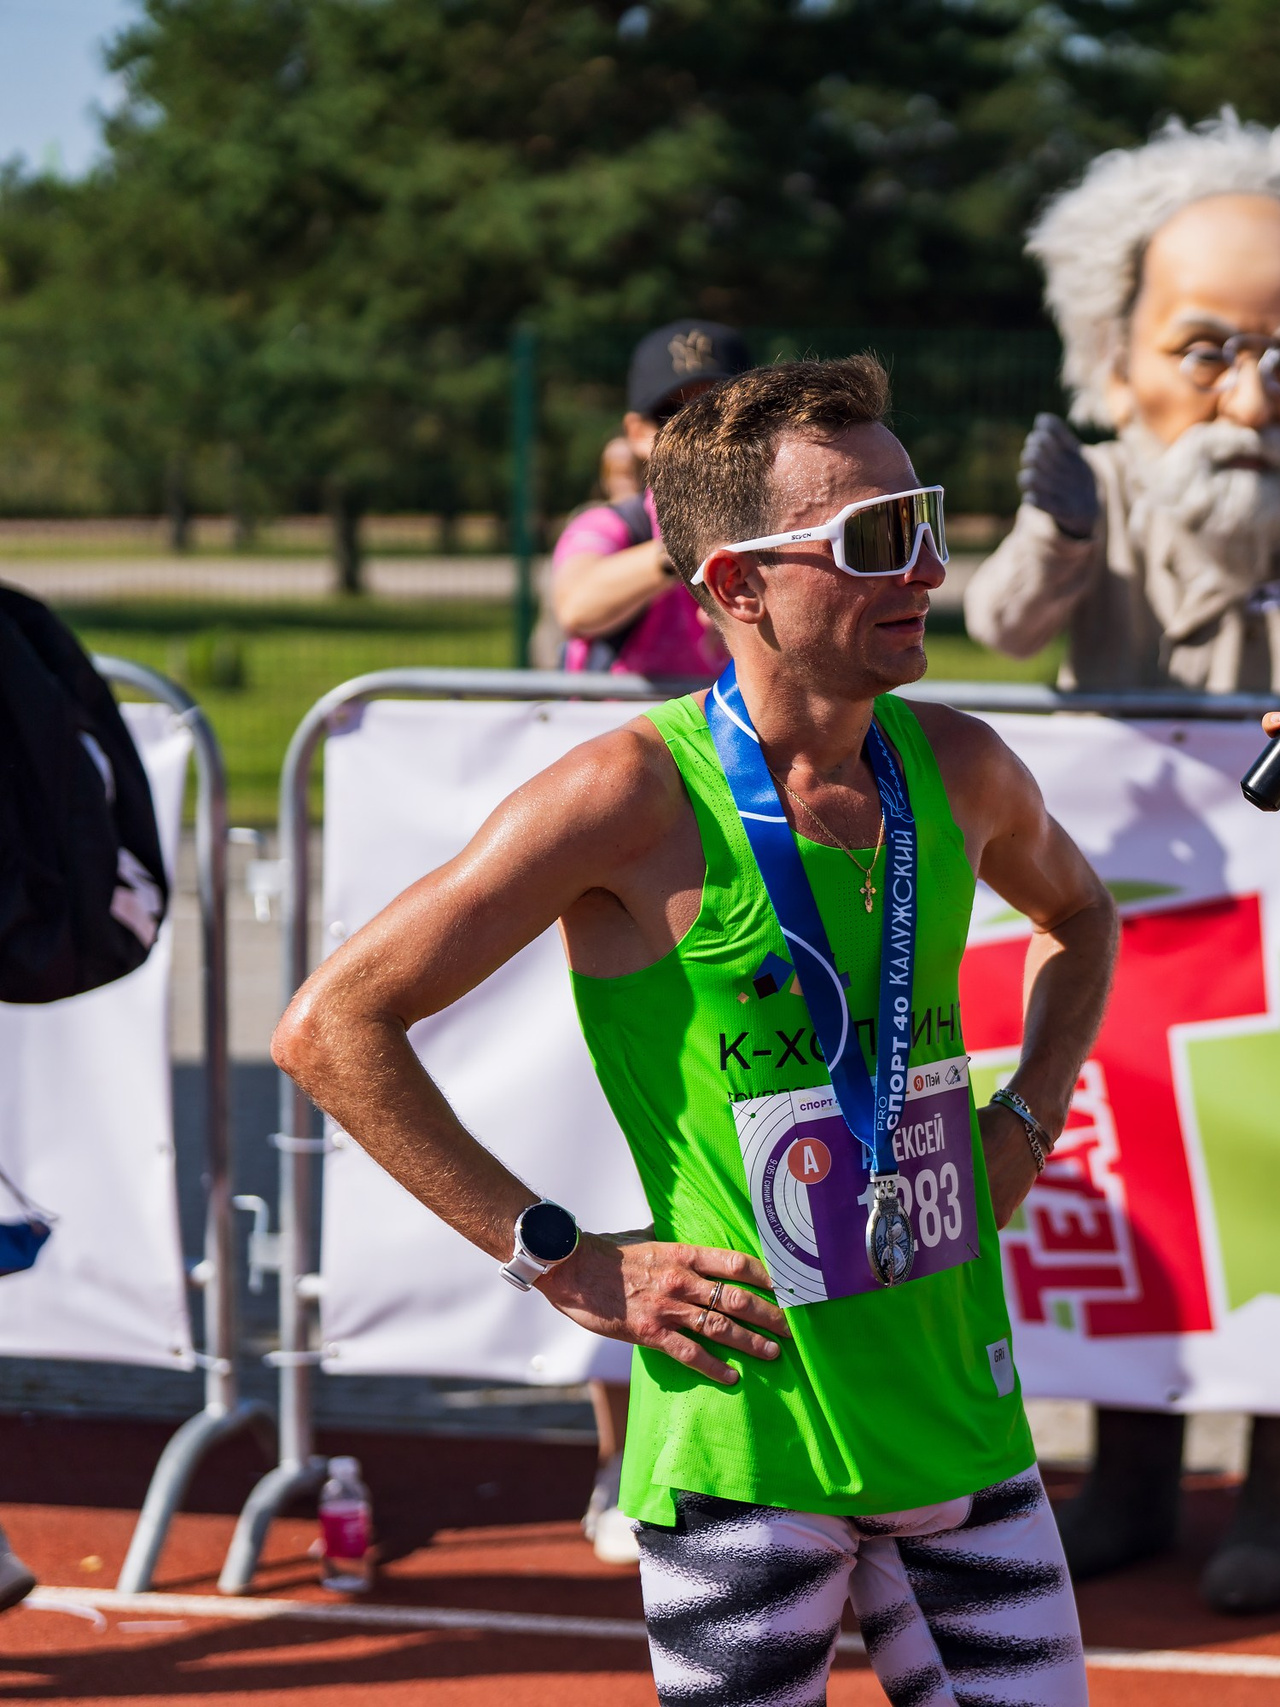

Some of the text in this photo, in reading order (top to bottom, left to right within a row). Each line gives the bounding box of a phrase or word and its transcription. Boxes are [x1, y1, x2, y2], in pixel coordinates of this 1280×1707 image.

[889, 830, 913, 985] КАЛУЖСКИЙ
[893, 996, 909, 1031] 40
[886, 1036, 909, 1131] СПОРТ
[925, 1073, 941, 1088] Пэй
[800, 1098, 833, 1112] СПОРТ
[877, 1096, 888, 1131] PRO
[862, 1113, 946, 1170] ЕКСЕЙ
[763, 1181, 772, 1203] синий
[1006, 1072, 1128, 1322] TEA
[765, 1204, 778, 1224] забег
